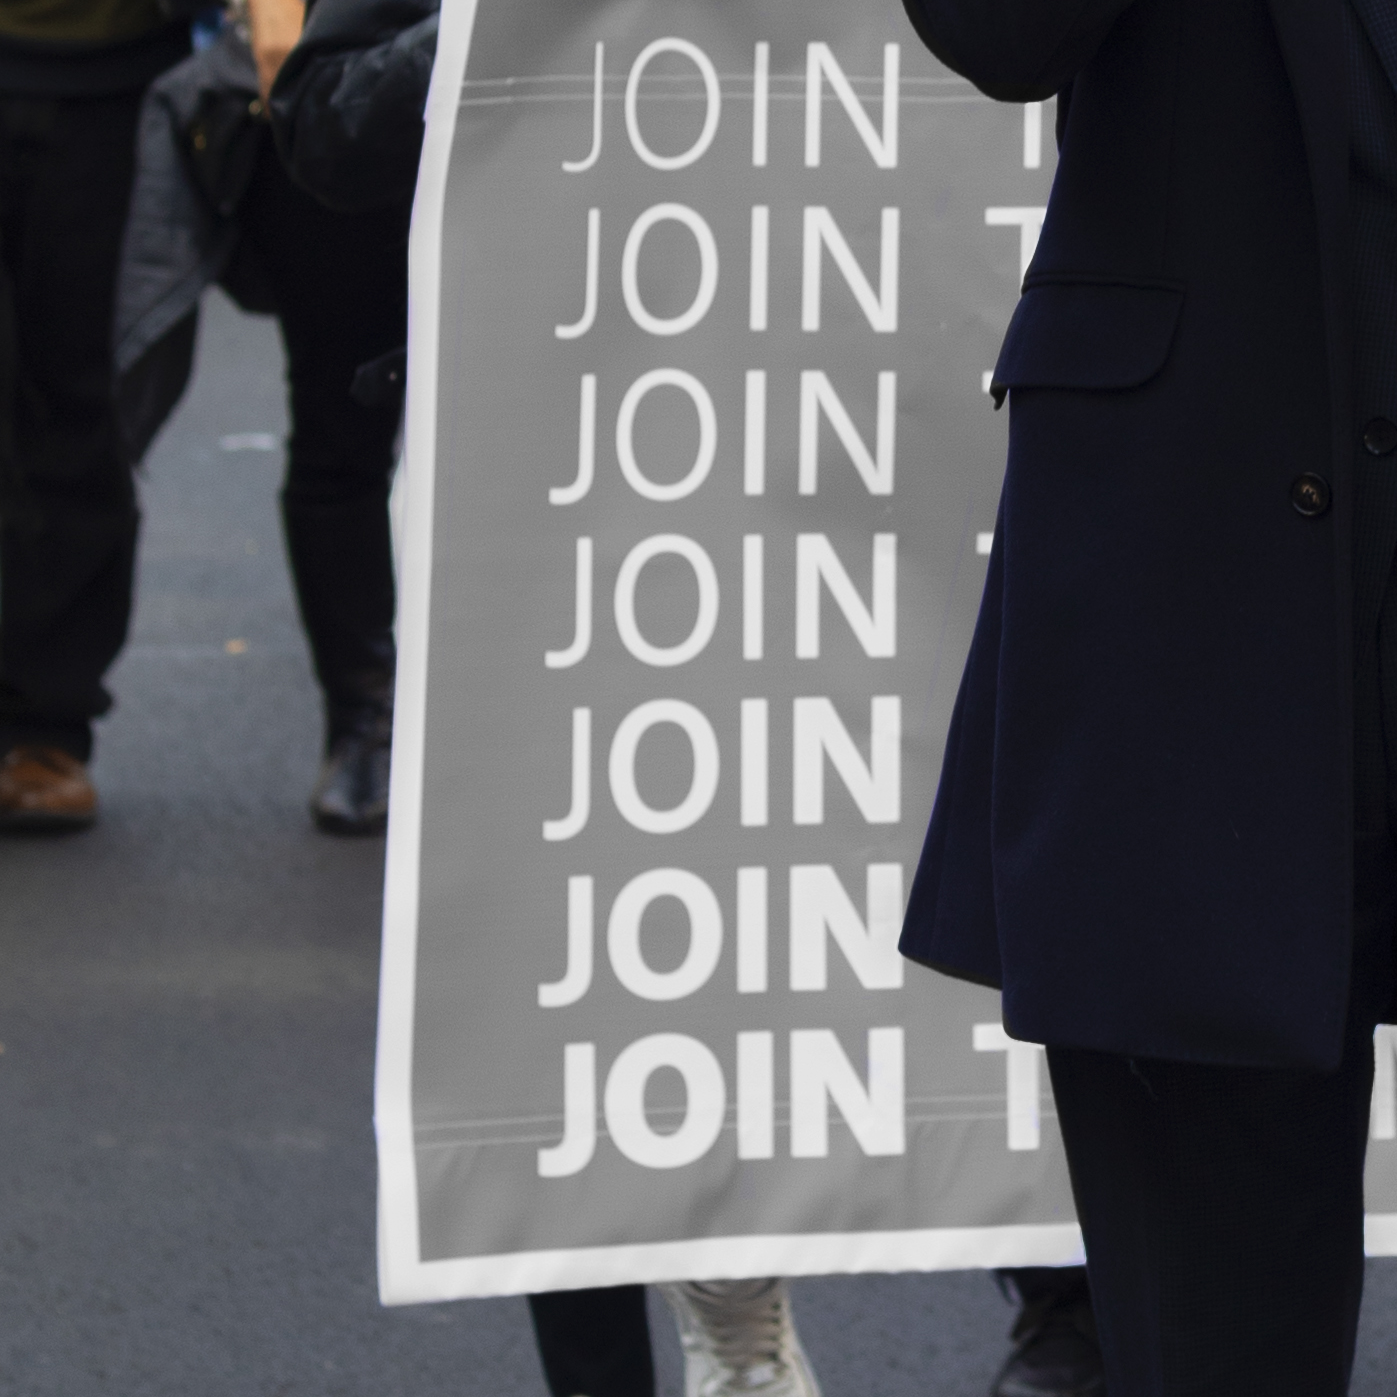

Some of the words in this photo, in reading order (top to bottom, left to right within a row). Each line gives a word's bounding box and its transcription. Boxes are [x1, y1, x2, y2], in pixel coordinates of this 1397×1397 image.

[562, 37, 899, 172] JOIN
[555, 203, 900, 339] JOIN
[549, 367, 897, 505] JOIN
[544, 533, 897, 670] JOIN
[542, 695, 902, 841] JOIN
[537, 863, 904, 1007] JOIN
[537, 1027, 906, 1178] JOIN
